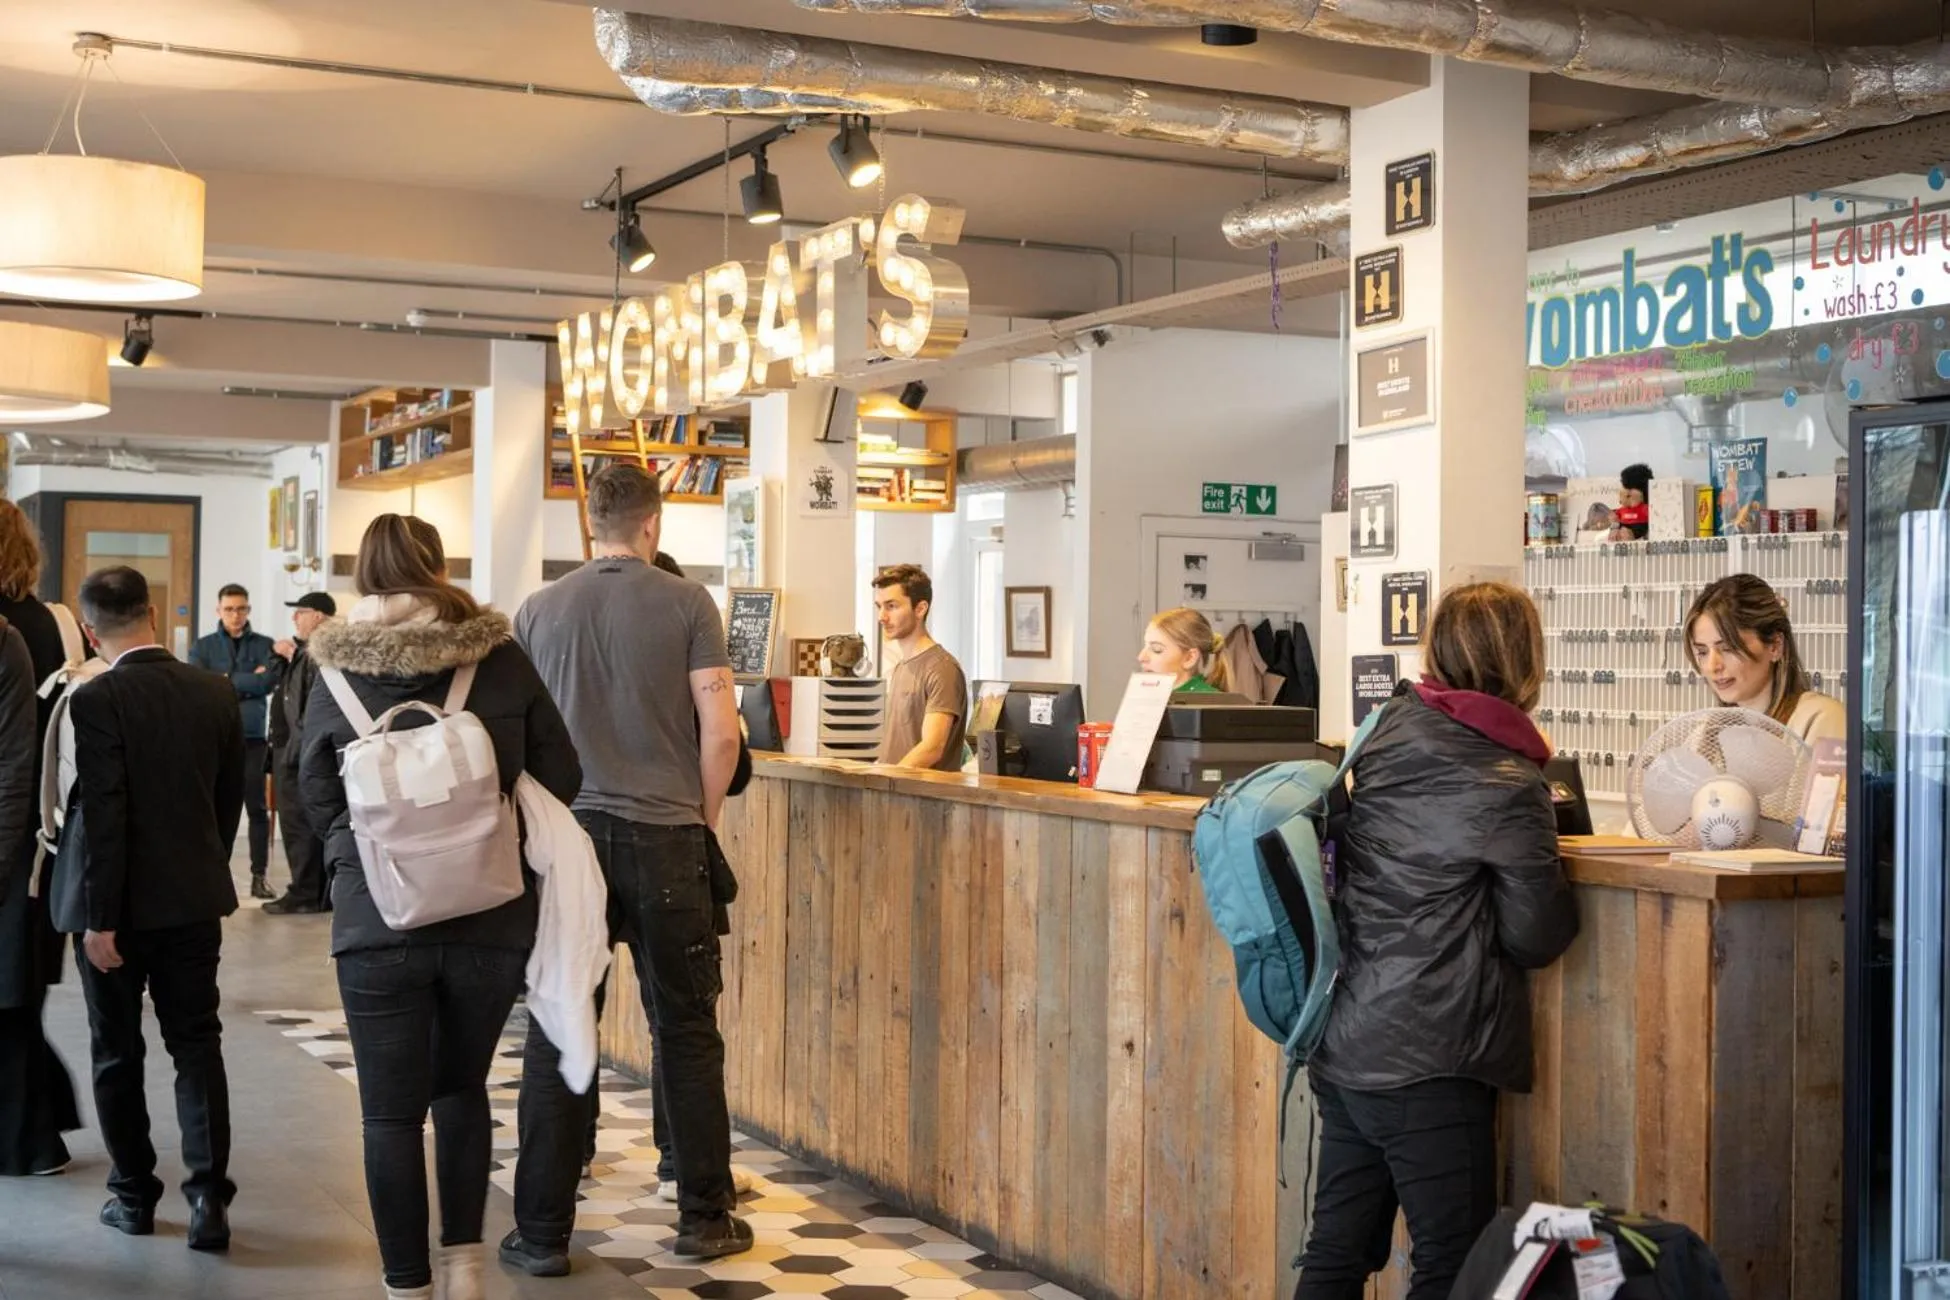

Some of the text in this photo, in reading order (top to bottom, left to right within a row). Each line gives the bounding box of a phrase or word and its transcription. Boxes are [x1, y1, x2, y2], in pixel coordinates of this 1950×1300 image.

[1849, 327, 1883, 371] dry
[1711, 442, 1763, 458] WOMBAT
[1717, 456, 1756, 473] STEW
[1203, 486, 1225, 498] Fire
[1203, 499, 1225, 511] exit
[1358, 673, 1390, 682] BEST EXTRA
[1356, 681, 1394, 690] LARGE HOSTEL
[1358, 690, 1392, 698] WORLDWIDE
